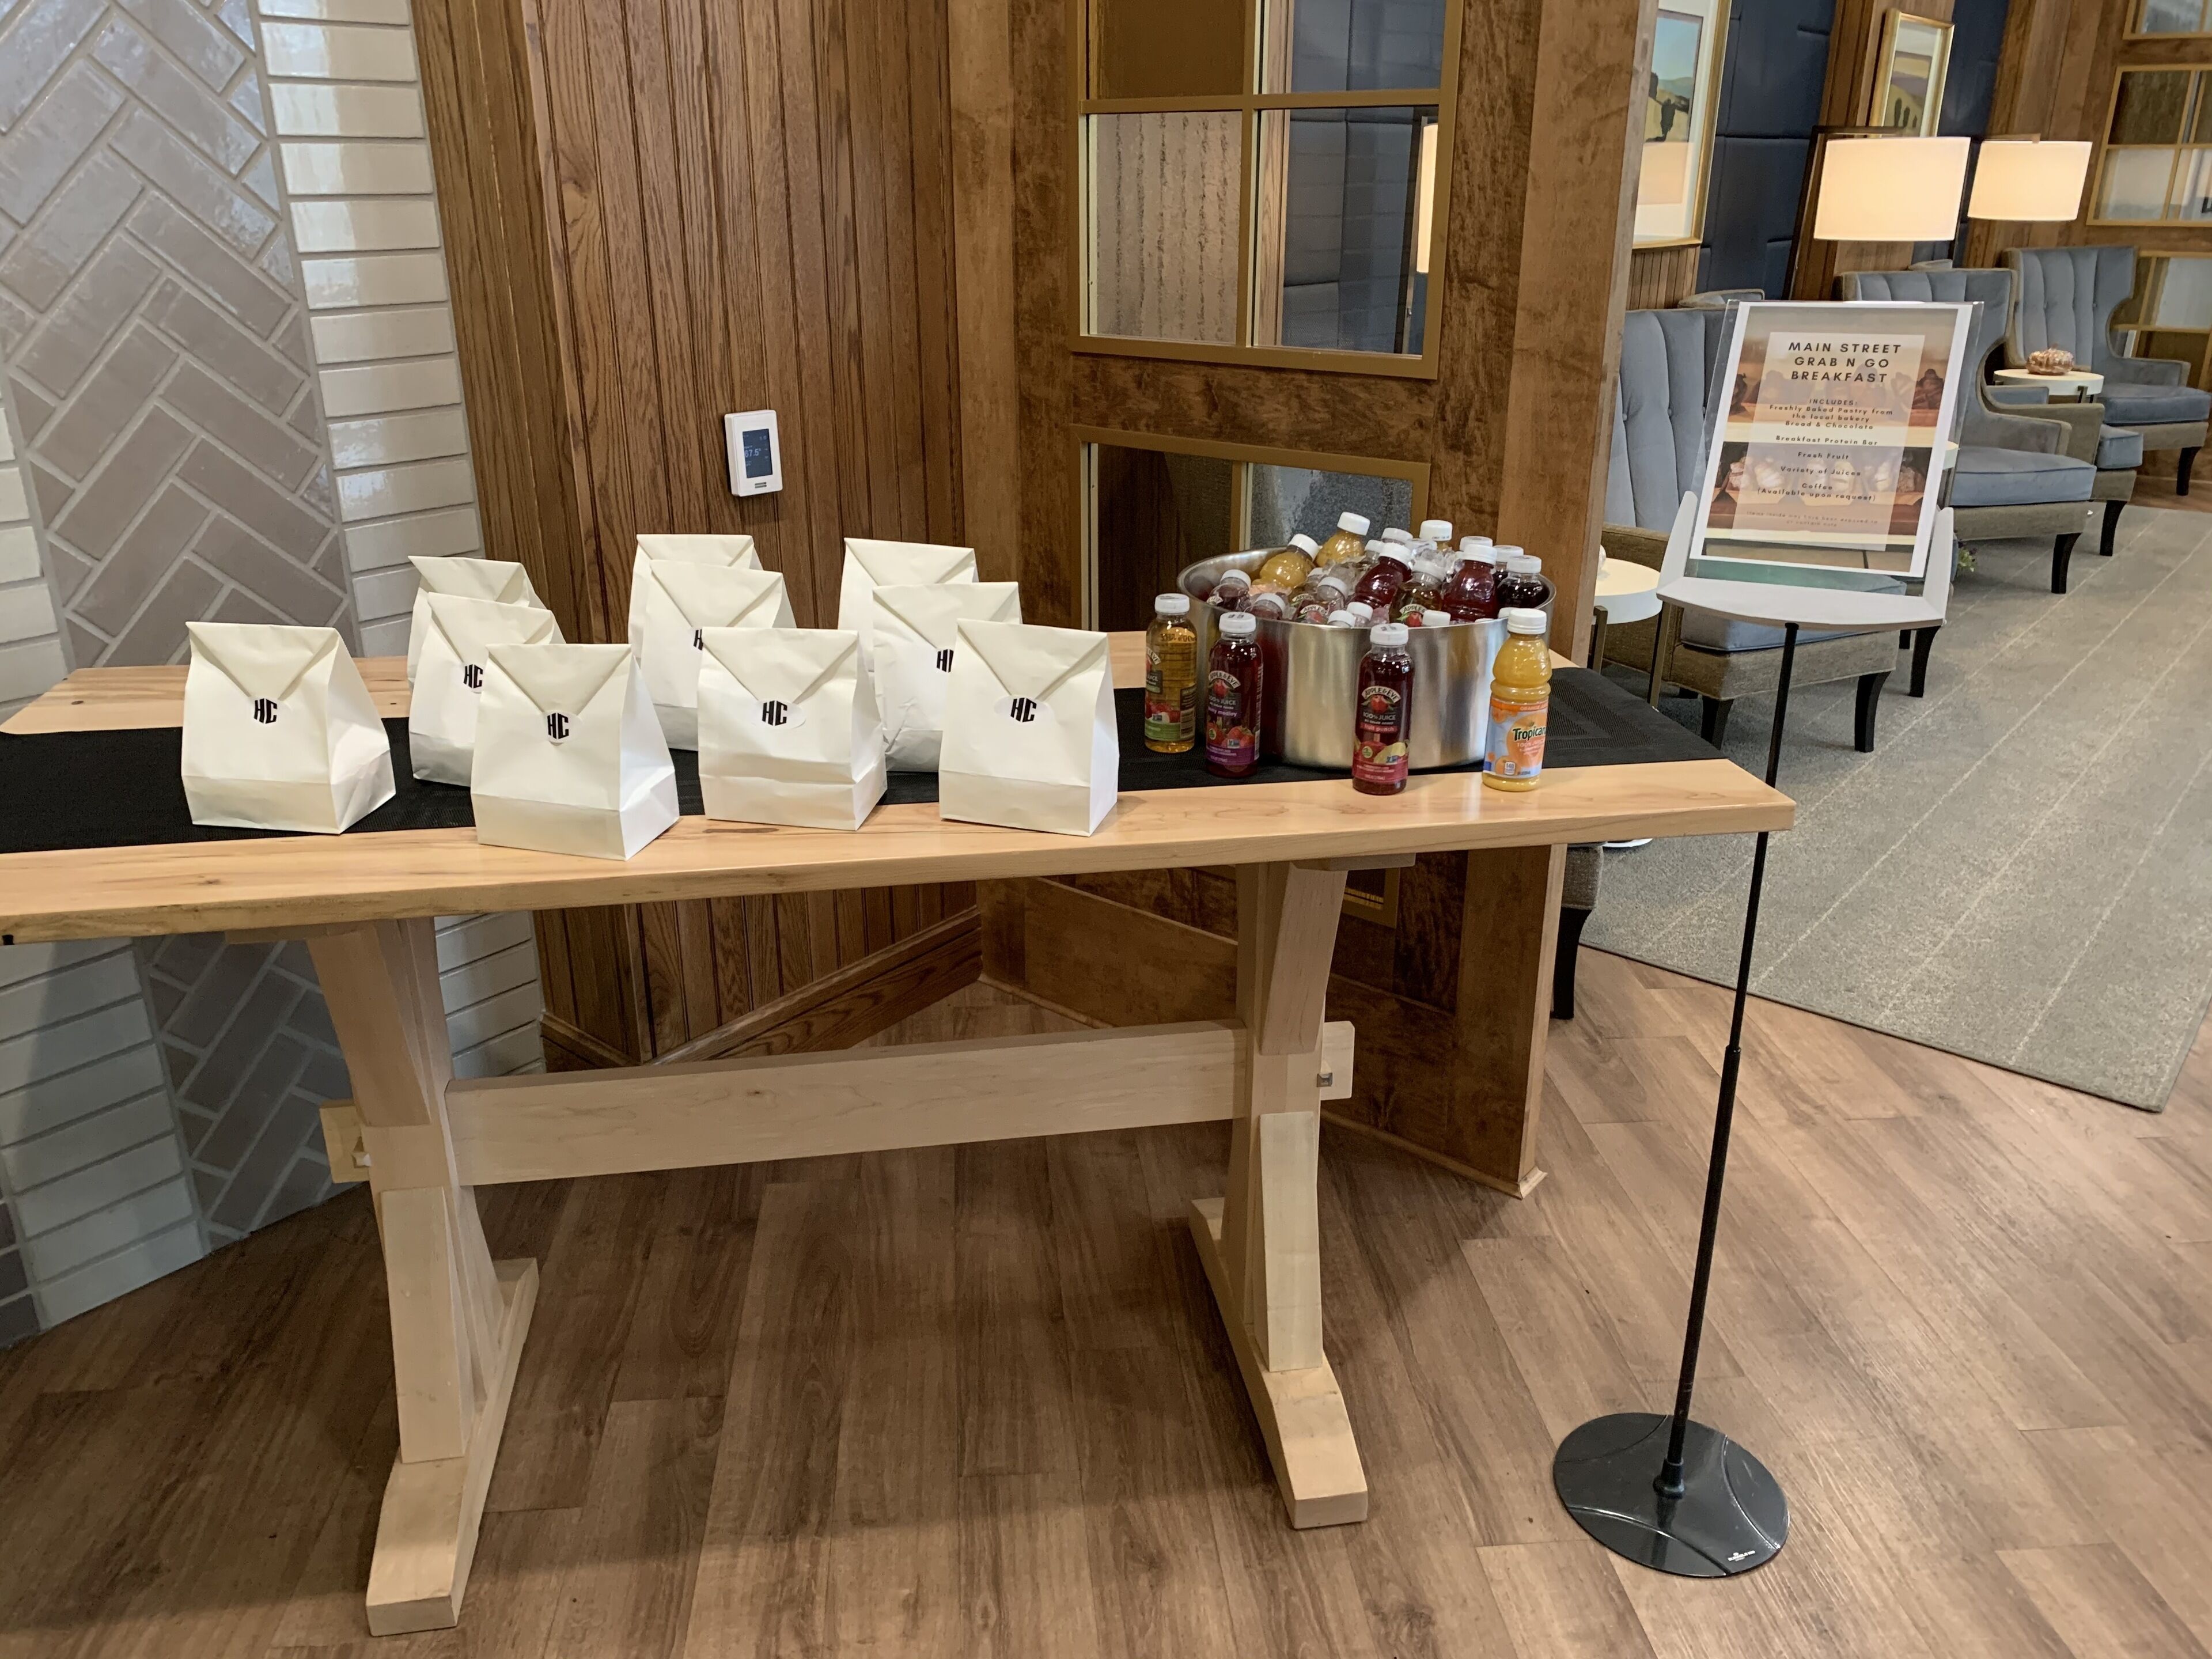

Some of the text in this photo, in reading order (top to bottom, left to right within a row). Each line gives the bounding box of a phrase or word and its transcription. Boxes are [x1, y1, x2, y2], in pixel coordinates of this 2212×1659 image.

[1788, 342, 1901, 354] MAIN STREET
[1794, 357, 1889, 368] GRAB N GO
[1791, 371, 1887, 382] BREAKFAST
[1769, 404, 1802, 412] Freshly
[1838, 415, 1870, 423] bakery
[1781, 466, 1814, 474] Variety
[1757, 487, 1805, 497] (Available
[694, 629, 704, 650] H
[463, 664, 484, 688] HC
[254, 698, 278, 724] HC
[762, 700, 787, 726] HC
[1010, 698, 1037, 722] HC
[1363, 711, 1378, 719] 100%
[547, 713, 569, 740] HC
[1512, 726, 1547, 741] Tropican
